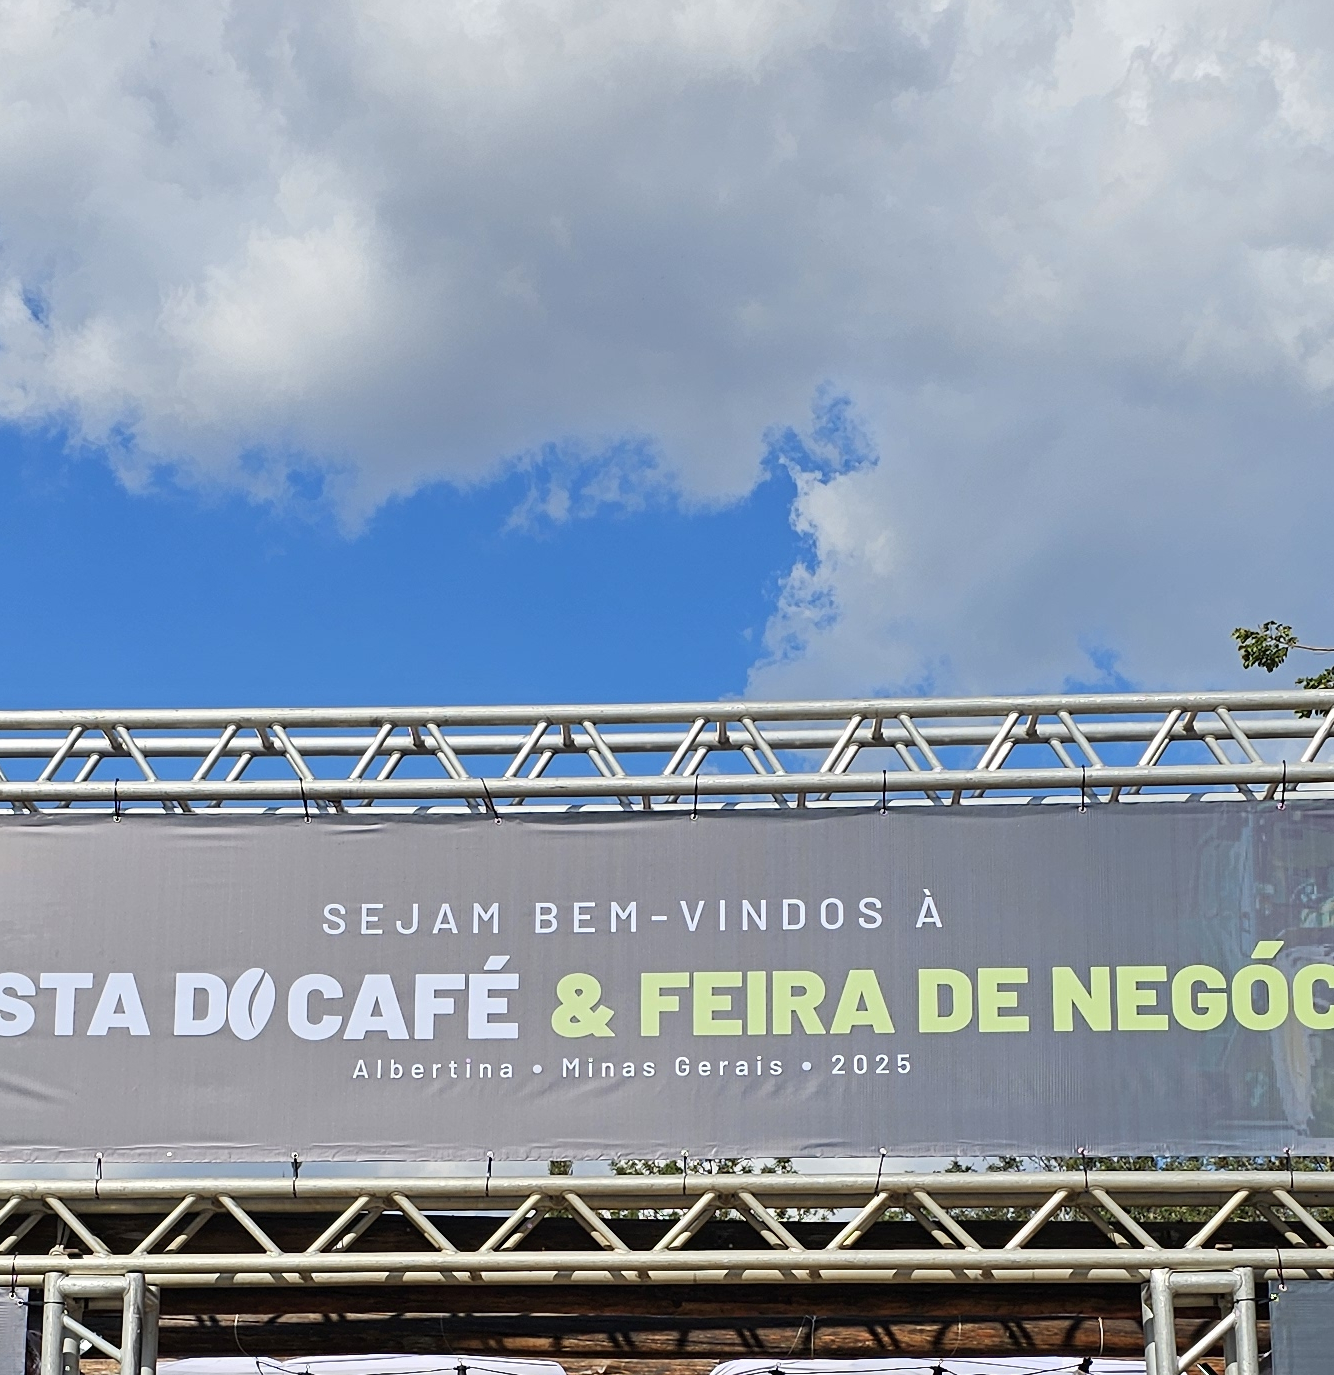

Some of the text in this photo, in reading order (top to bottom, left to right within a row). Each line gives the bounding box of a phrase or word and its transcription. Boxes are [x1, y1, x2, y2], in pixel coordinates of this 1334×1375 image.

[322, 889, 943, 934] SEJAM BEM-VINDOS À
[173, 967, 276, 1040] DO
[286, 955, 520, 1040] CAFÉ
[550, 972, 616, 1038] &
[640, 968, 895, 1036] FEIRA
[918, 966, 1029, 1034] DE
[352, 1053, 913, 1079] Albertina Minas Gerais 2025
